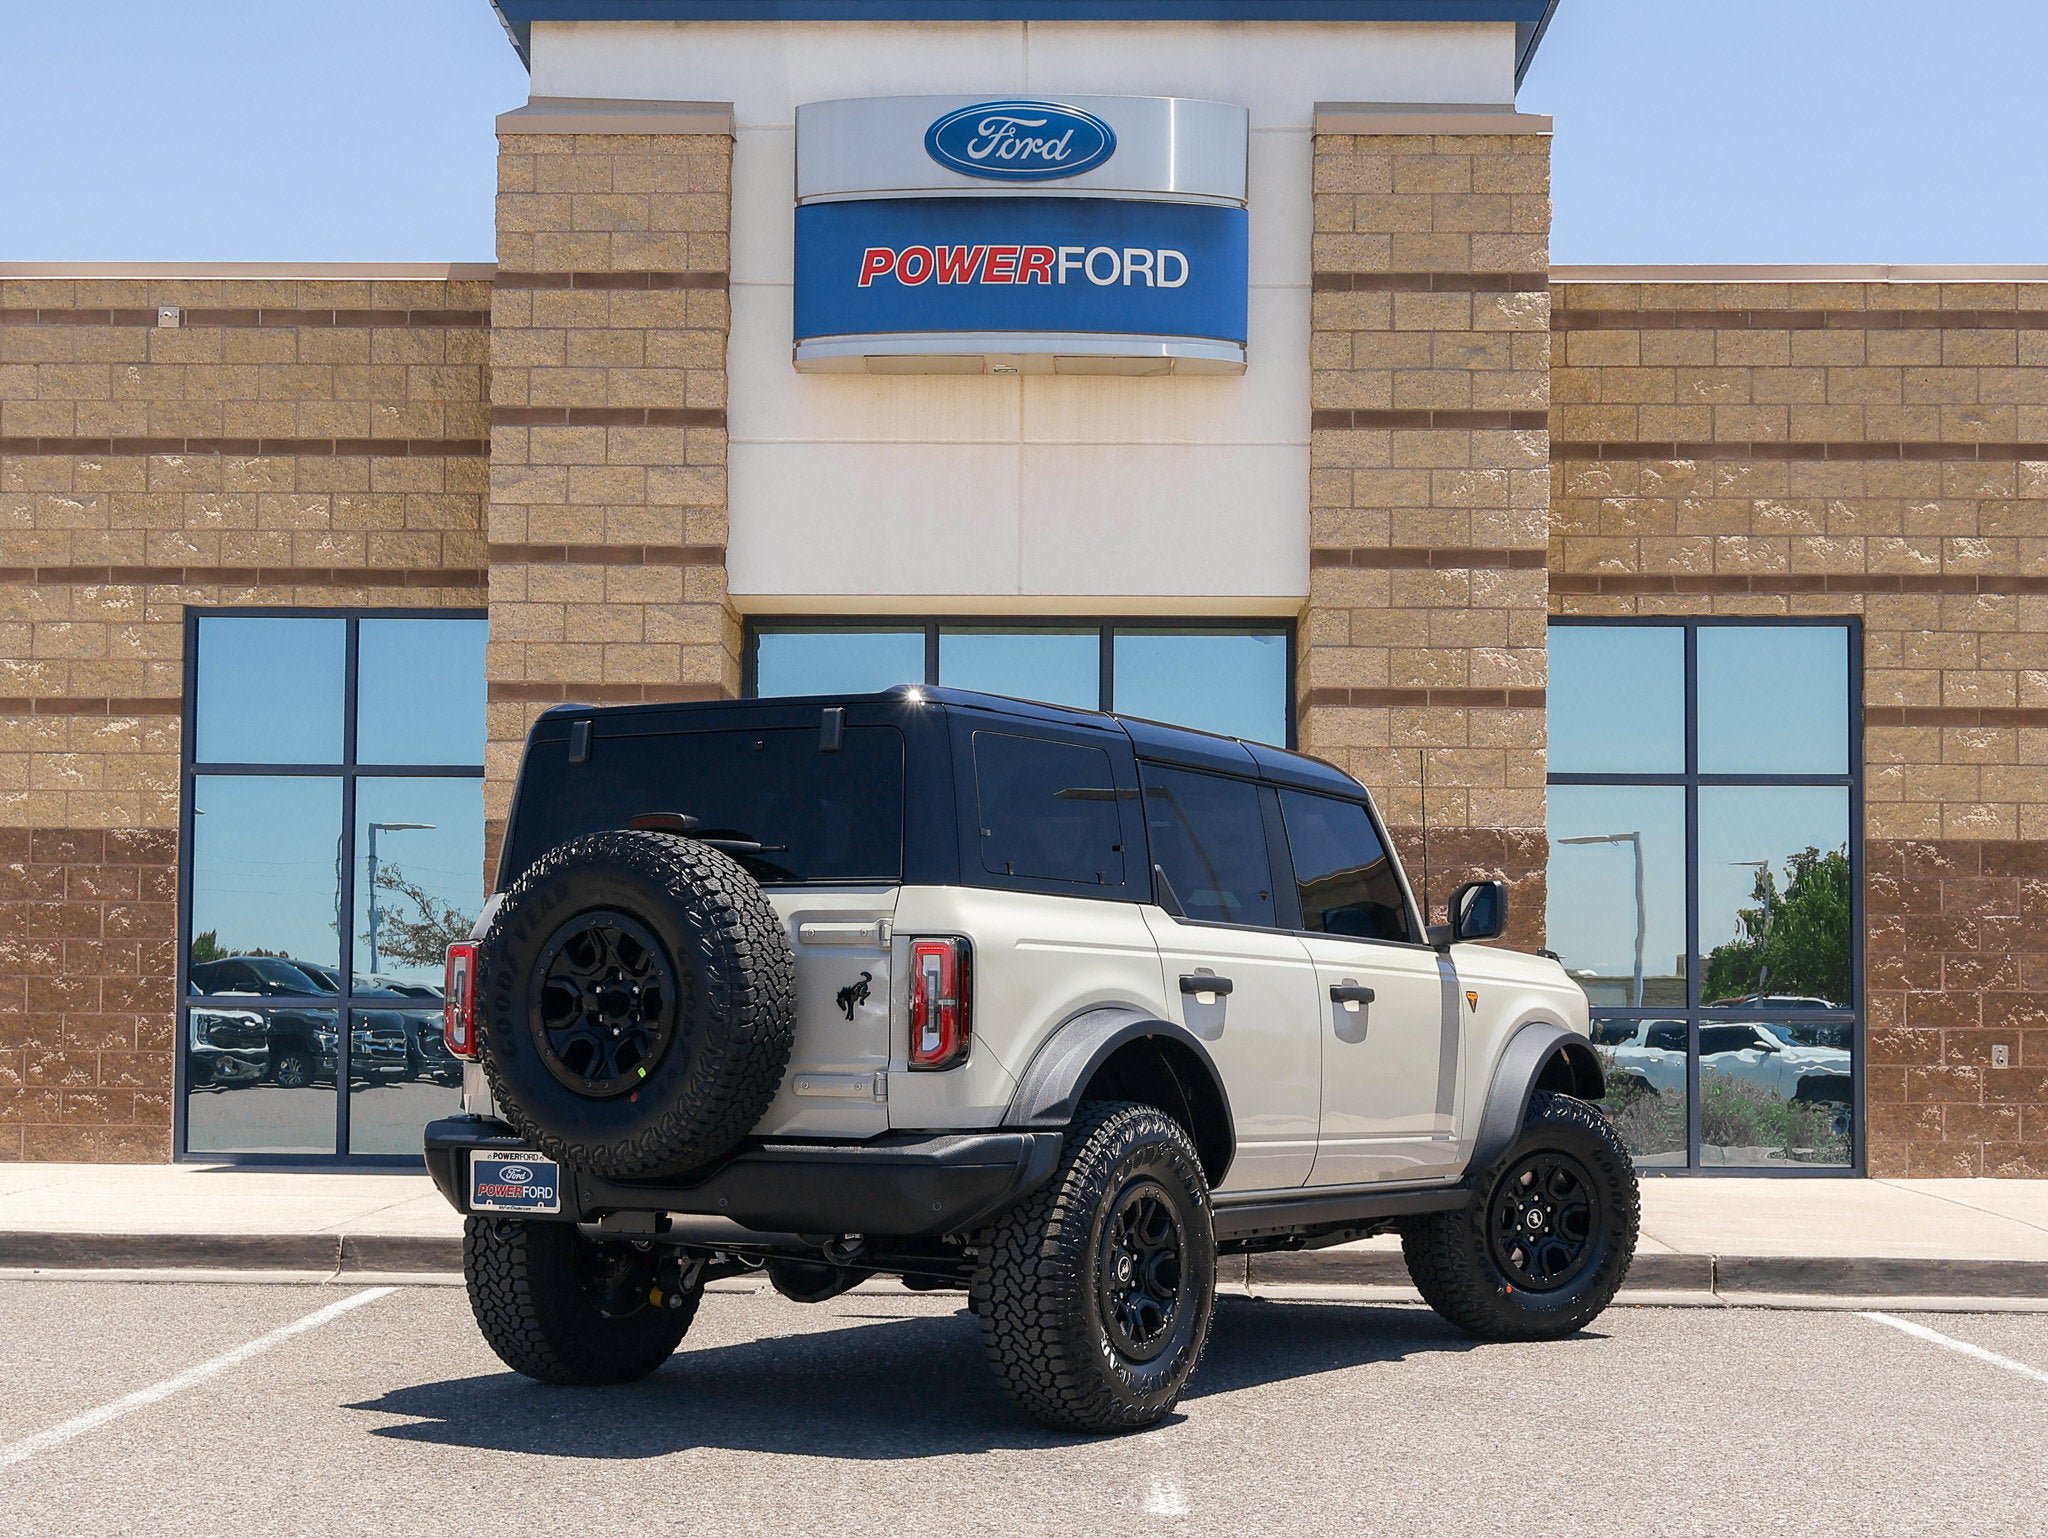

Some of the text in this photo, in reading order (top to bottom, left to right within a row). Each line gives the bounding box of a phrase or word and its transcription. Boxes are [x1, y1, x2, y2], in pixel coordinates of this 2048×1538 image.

[966, 116, 1072, 161] Ford
[857, 245, 1190, 288] POWERFORD
[493, 1152, 539, 1161] POWERFORD
[505, 1168, 527, 1180] Ford
[478, 1183, 554, 1199] POWERFORD
